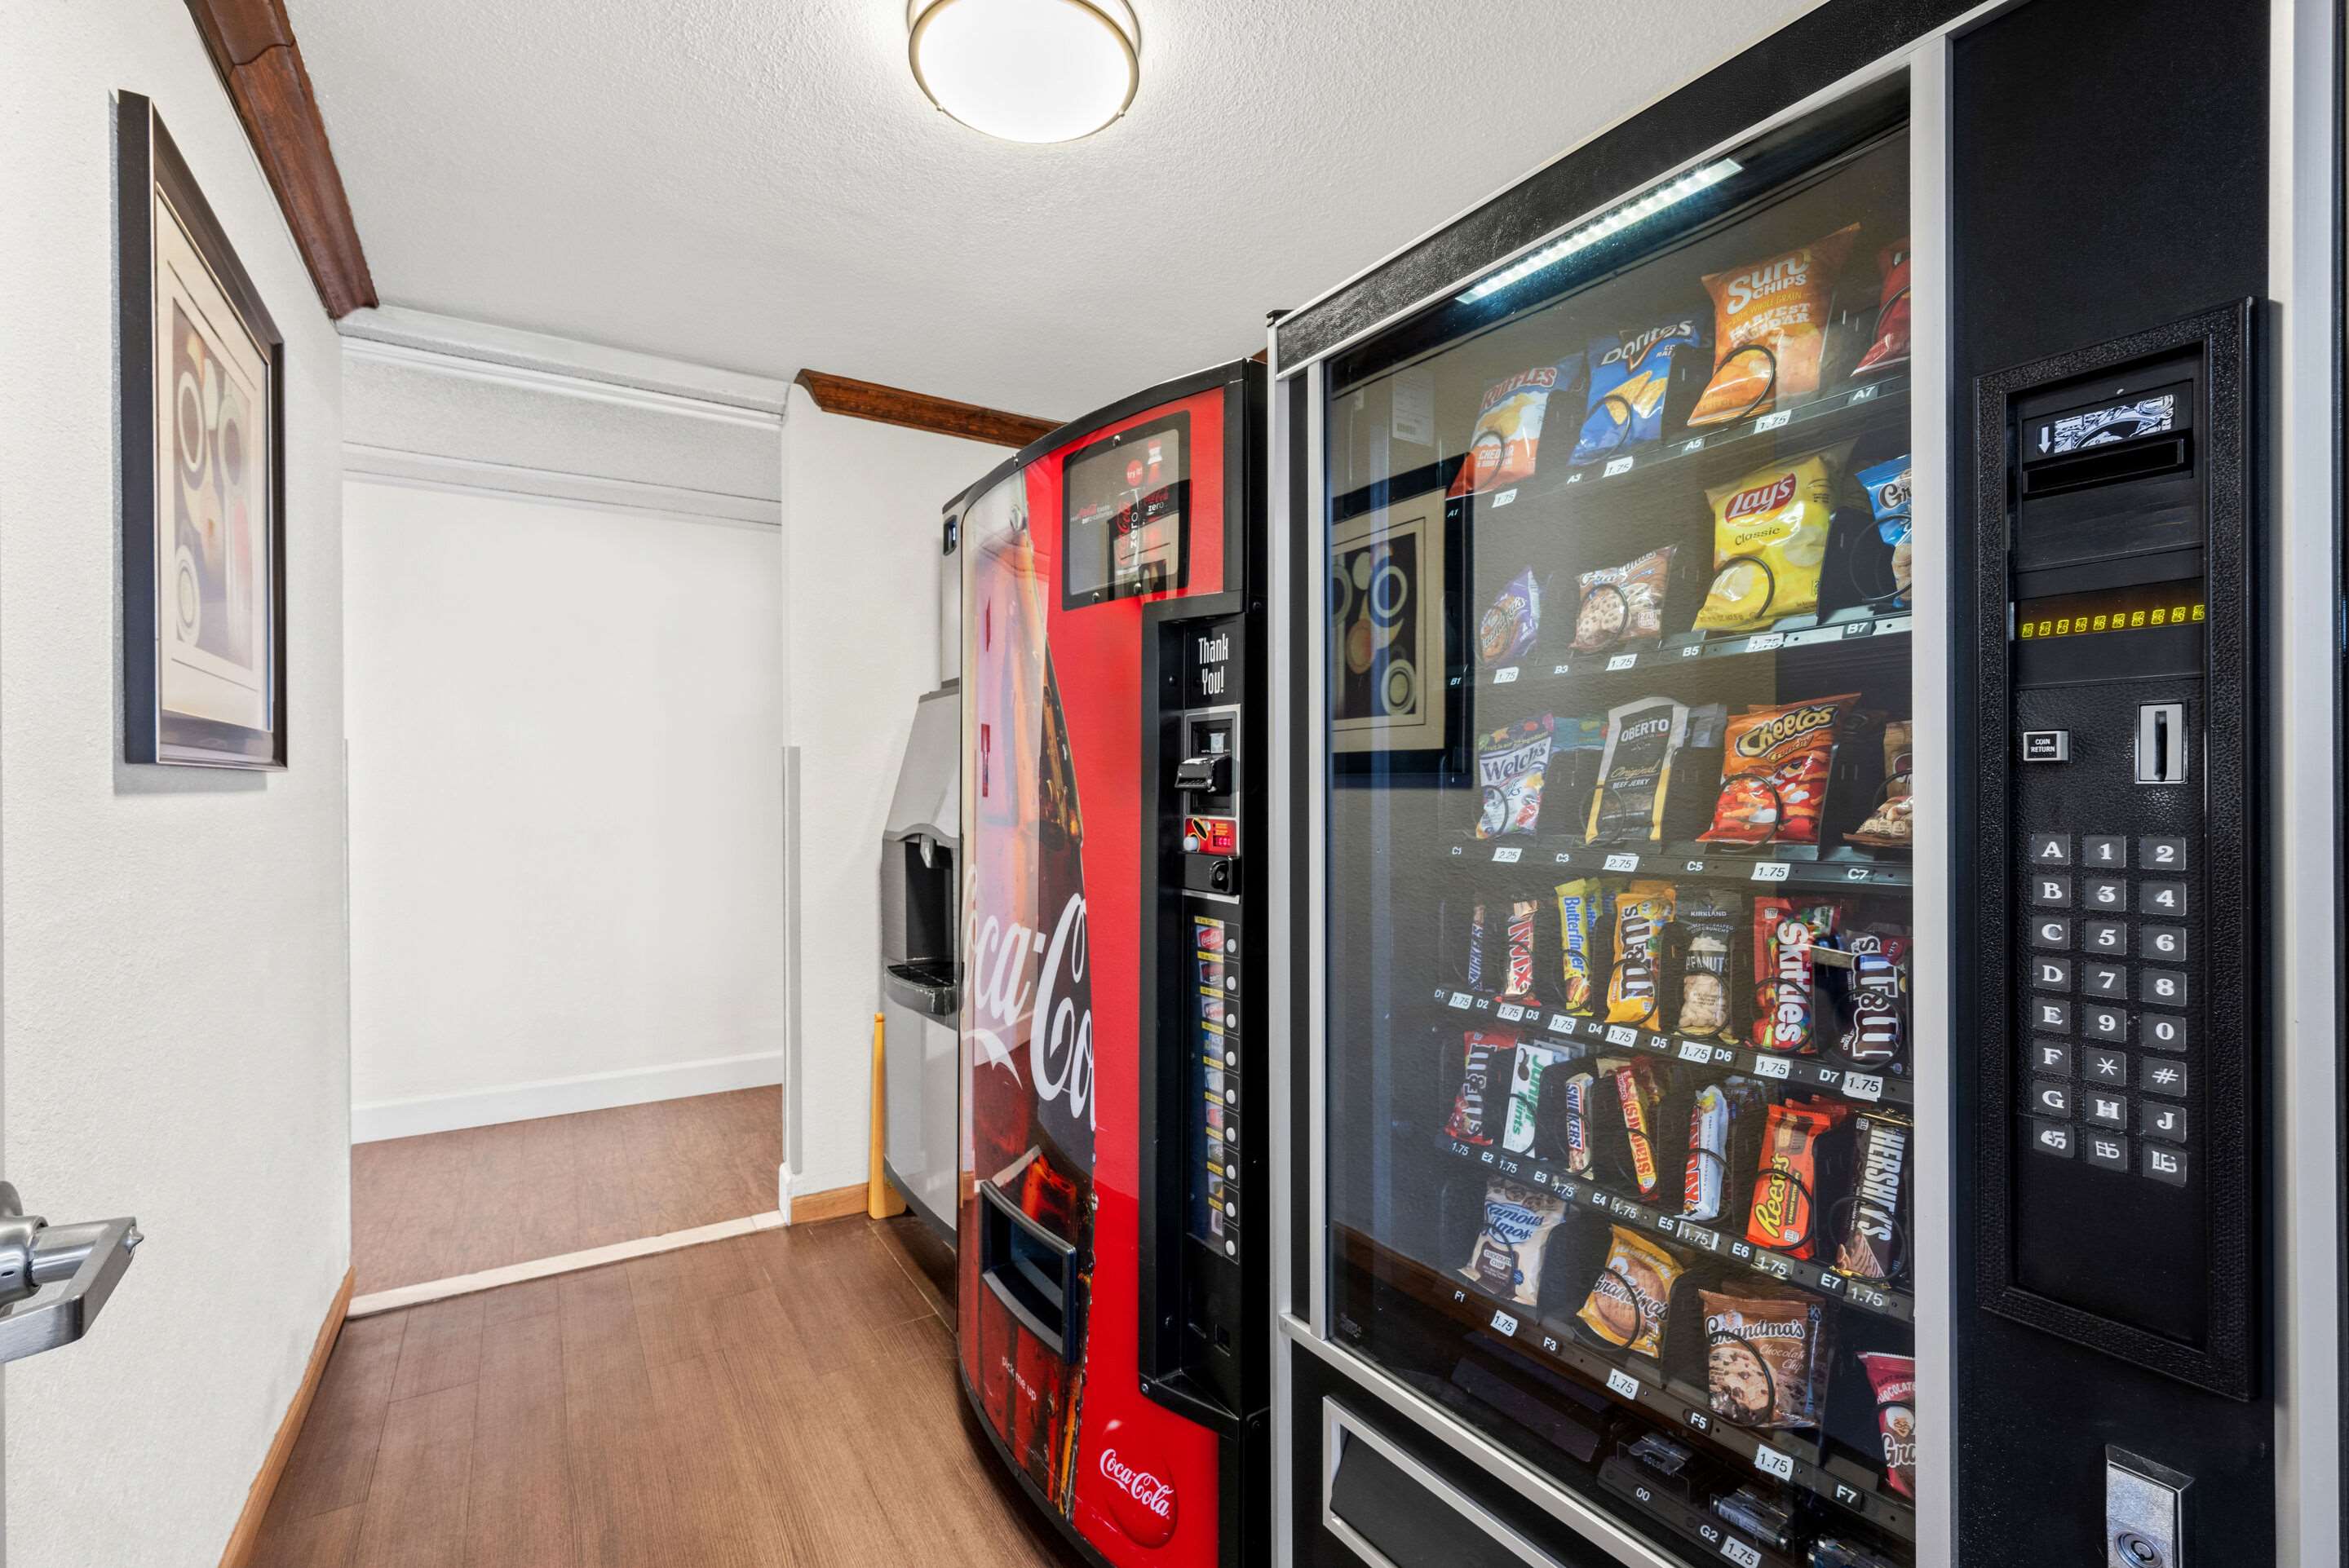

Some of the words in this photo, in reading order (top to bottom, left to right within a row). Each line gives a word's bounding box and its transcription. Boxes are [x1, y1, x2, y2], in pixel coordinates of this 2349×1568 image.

[1727, 258, 1812, 315] Sun
[1752, 273, 1807, 299] CHIPS
[1601, 320, 1693, 366] Doritos
[1481, 367, 1557, 409] RUFFLES
[1853, 386, 1876, 401] A7
[1685, 438, 1702, 450] A5
[1608, 463, 1630, 475] 1.75
[1566, 473, 1582, 484] A3
[1728, 475, 1793, 519] Lay's
[1148, 501, 1165, 512] zero
[1447, 509, 1458, 518] A1
[1130, 511, 1139, 549] zero
[1734, 527, 1781, 546] Classic
[1846, 621, 1868, 634] B7
[1197, 634, 1229, 665] Thank
[1682, 647, 1700, 657] B5
[1554, 665, 1568, 674] B3
[1610, 657, 1633, 667] 1.75
[1201, 665, 1224, 696] You!
[1449, 677, 1462, 686] B1
[1620, 718, 1670, 742] OBERTO
[1737, 705, 1835, 754] Cheetos
[2030, 746, 2055, 754] RETURN
[2034, 738, 2050, 746] COIN
[1481, 743, 1547, 781] Welch's
[1612, 760, 1661, 780] Original
[1612, 781, 1628, 790] BEEF
[1629, 778, 1650, 788] JERKY
[1498, 850, 1518, 859] 2.25
[1555, 853, 1569, 862] C3
[2042, 841, 2064, 859] A
[2099, 843, 2112, 860] 1
[2156, 845, 2174, 863] 2
[1608, 859, 1632, 868] 2.75
[1687, 861, 1703, 871] C5
[1758, 866, 1785, 877] 1.75
[1847, 868, 1869, 880] C7
[2042, 882, 2063, 899] B
[2097, 886, 2116, 903] 3
[2156, 890, 2174, 908] 4
[2042, 924, 2063, 941] C
[2098, 929, 2116, 946] 5
[2156, 934, 2174, 952] 6
[1508, 919, 1533, 989] TWIX
[1685, 956, 1731, 974] PEANUTS
[1775, 921, 1811, 1043] Skittles
[2042, 965, 2064, 983] D
[2098, 971, 2116, 989] 7
[1435, 989, 1445, 999] D1
[2156, 978, 2174, 996] 8
[1452, 996, 1470, 1007] 1.75
[1476, 999, 1489, 1009] D2
[1500, 1006, 1520, 1018] 1.75
[1526, 1010, 1540, 1021] D3
[2042, 1006, 2063, 1024] E
[1551, 1017, 1574, 1031] 1.75
[1588, 1023, 1603, 1035] D4
[2098, 1014, 2116, 1031] 9
[1610, 1029, 1632, 1043] 1.75
[2156, 1023, 2174, 1040] 0
[1651, 1036, 1668, 1049] D5
[1683, 1047, 1708, 1061] 1.75
[1714, 1049, 1732, 1062] D6
[2042, 1049, 2063, 1065] F
[1758, 1061, 1787, 1076] 1.75
[1819, 1069, 1839, 1083] D7
[1848, 1078, 1880, 1093] 1.75
[2042, 1091, 2064, 1109] G
[1566, 1084, 1582, 1150] SNIKERS
[2095, 1099, 2120, 1120] H
[2157, 1112, 2175, 1130] J
[1451, 1141, 1470, 1156] 1.75
[1481, 1151, 1493, 1164] E2
[1499, 1159, 1519, 1174] 1.75
[1534, 1171, 1547, 1183] E3
[1856, 1129, 1905, 1241] HERSHEY'S
[1553, 1182, 1575, 1197] 1.75
[1754, 1153, 1789, 1239] Reese's
[1592, 1193, 1606, 1207] E4
[1613, 1202, 1638, 1219] 1.75
[1658, 1217, 1674, 1231] E5
[1683, 1226, 1710, 1246] 1.75
[1732, 1243, 1750, 1258] E6
[1492, 1259, 1505, 1270] CHIP
[1760, 1257, 1789, 1275] 1.75
[1820, 1274, 1842, 1288] E7
[1454, 1290, 1466, 1303] F1
[1851, 1287, 1884, 1306] 1.75
[1494, 1314, 1515, 1332] 1.75
[1705, 1315, 1806, 1346] Grandma's
[1543, 1336, 1557, 1352] F3
[1782, 1359, 1804, 1374] Chip
[1015, 1372, 1026, 1390] me
[1027, 1385, 1037, 1401] up
[1610, 1374, 1635, 1394] 1.75
[1690, 1411, 1708, 1429] F5
[1759, 1452, 1789, 1473] 1.75
[1099, 1448, 1174, 1517] Coca-Cola
[1636, 1486, 1651, 1502] 00
[1836, 1483, 1858, 1504] F7
[1699, 1524, 1719, 1544] G2
[1727, 1540, 1755, 1566] 1.75
